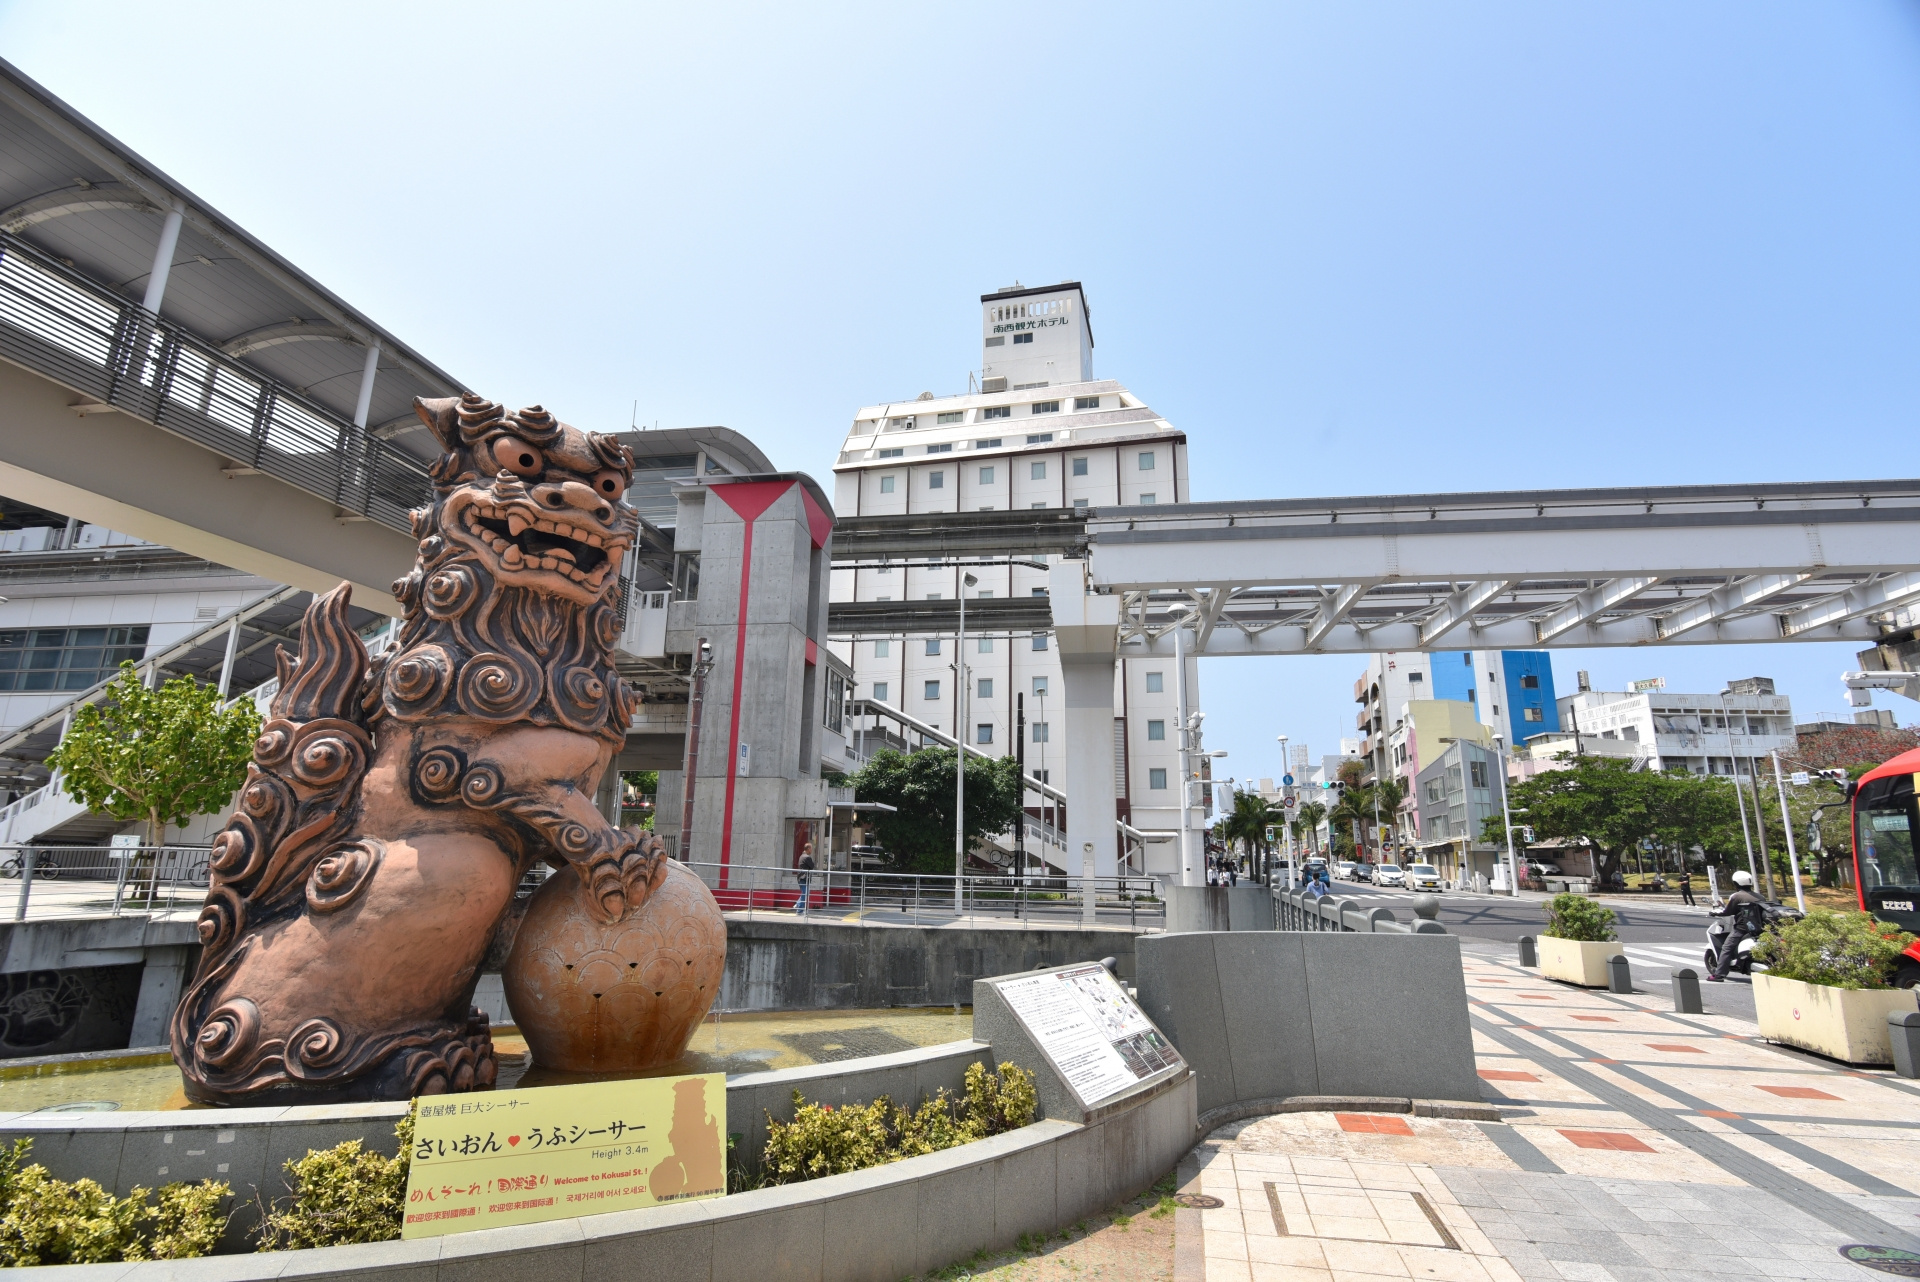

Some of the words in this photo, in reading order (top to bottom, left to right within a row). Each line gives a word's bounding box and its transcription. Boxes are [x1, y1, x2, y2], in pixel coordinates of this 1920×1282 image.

[993, 317, 1068, 334] 南西観光ホテル
[461, 1100, 529, 1114] 巨大シーサー
[416, 1132, 502, 1159] さいおん
[527, 1121, 646, 1149] うふシーサー
[592, 1149, 621, 1160] Height
[625, 1146, 649, 1156] 3.4m
[554, 1177, 589, 1186] Welcome
[601, 1170, 632, 1180] Kokusai
[566, 1190, 605, 1203] 국제거리에
[606, 1188, 621, 1198] 어서
[623, 1185, 647, 1195] 오세요!
